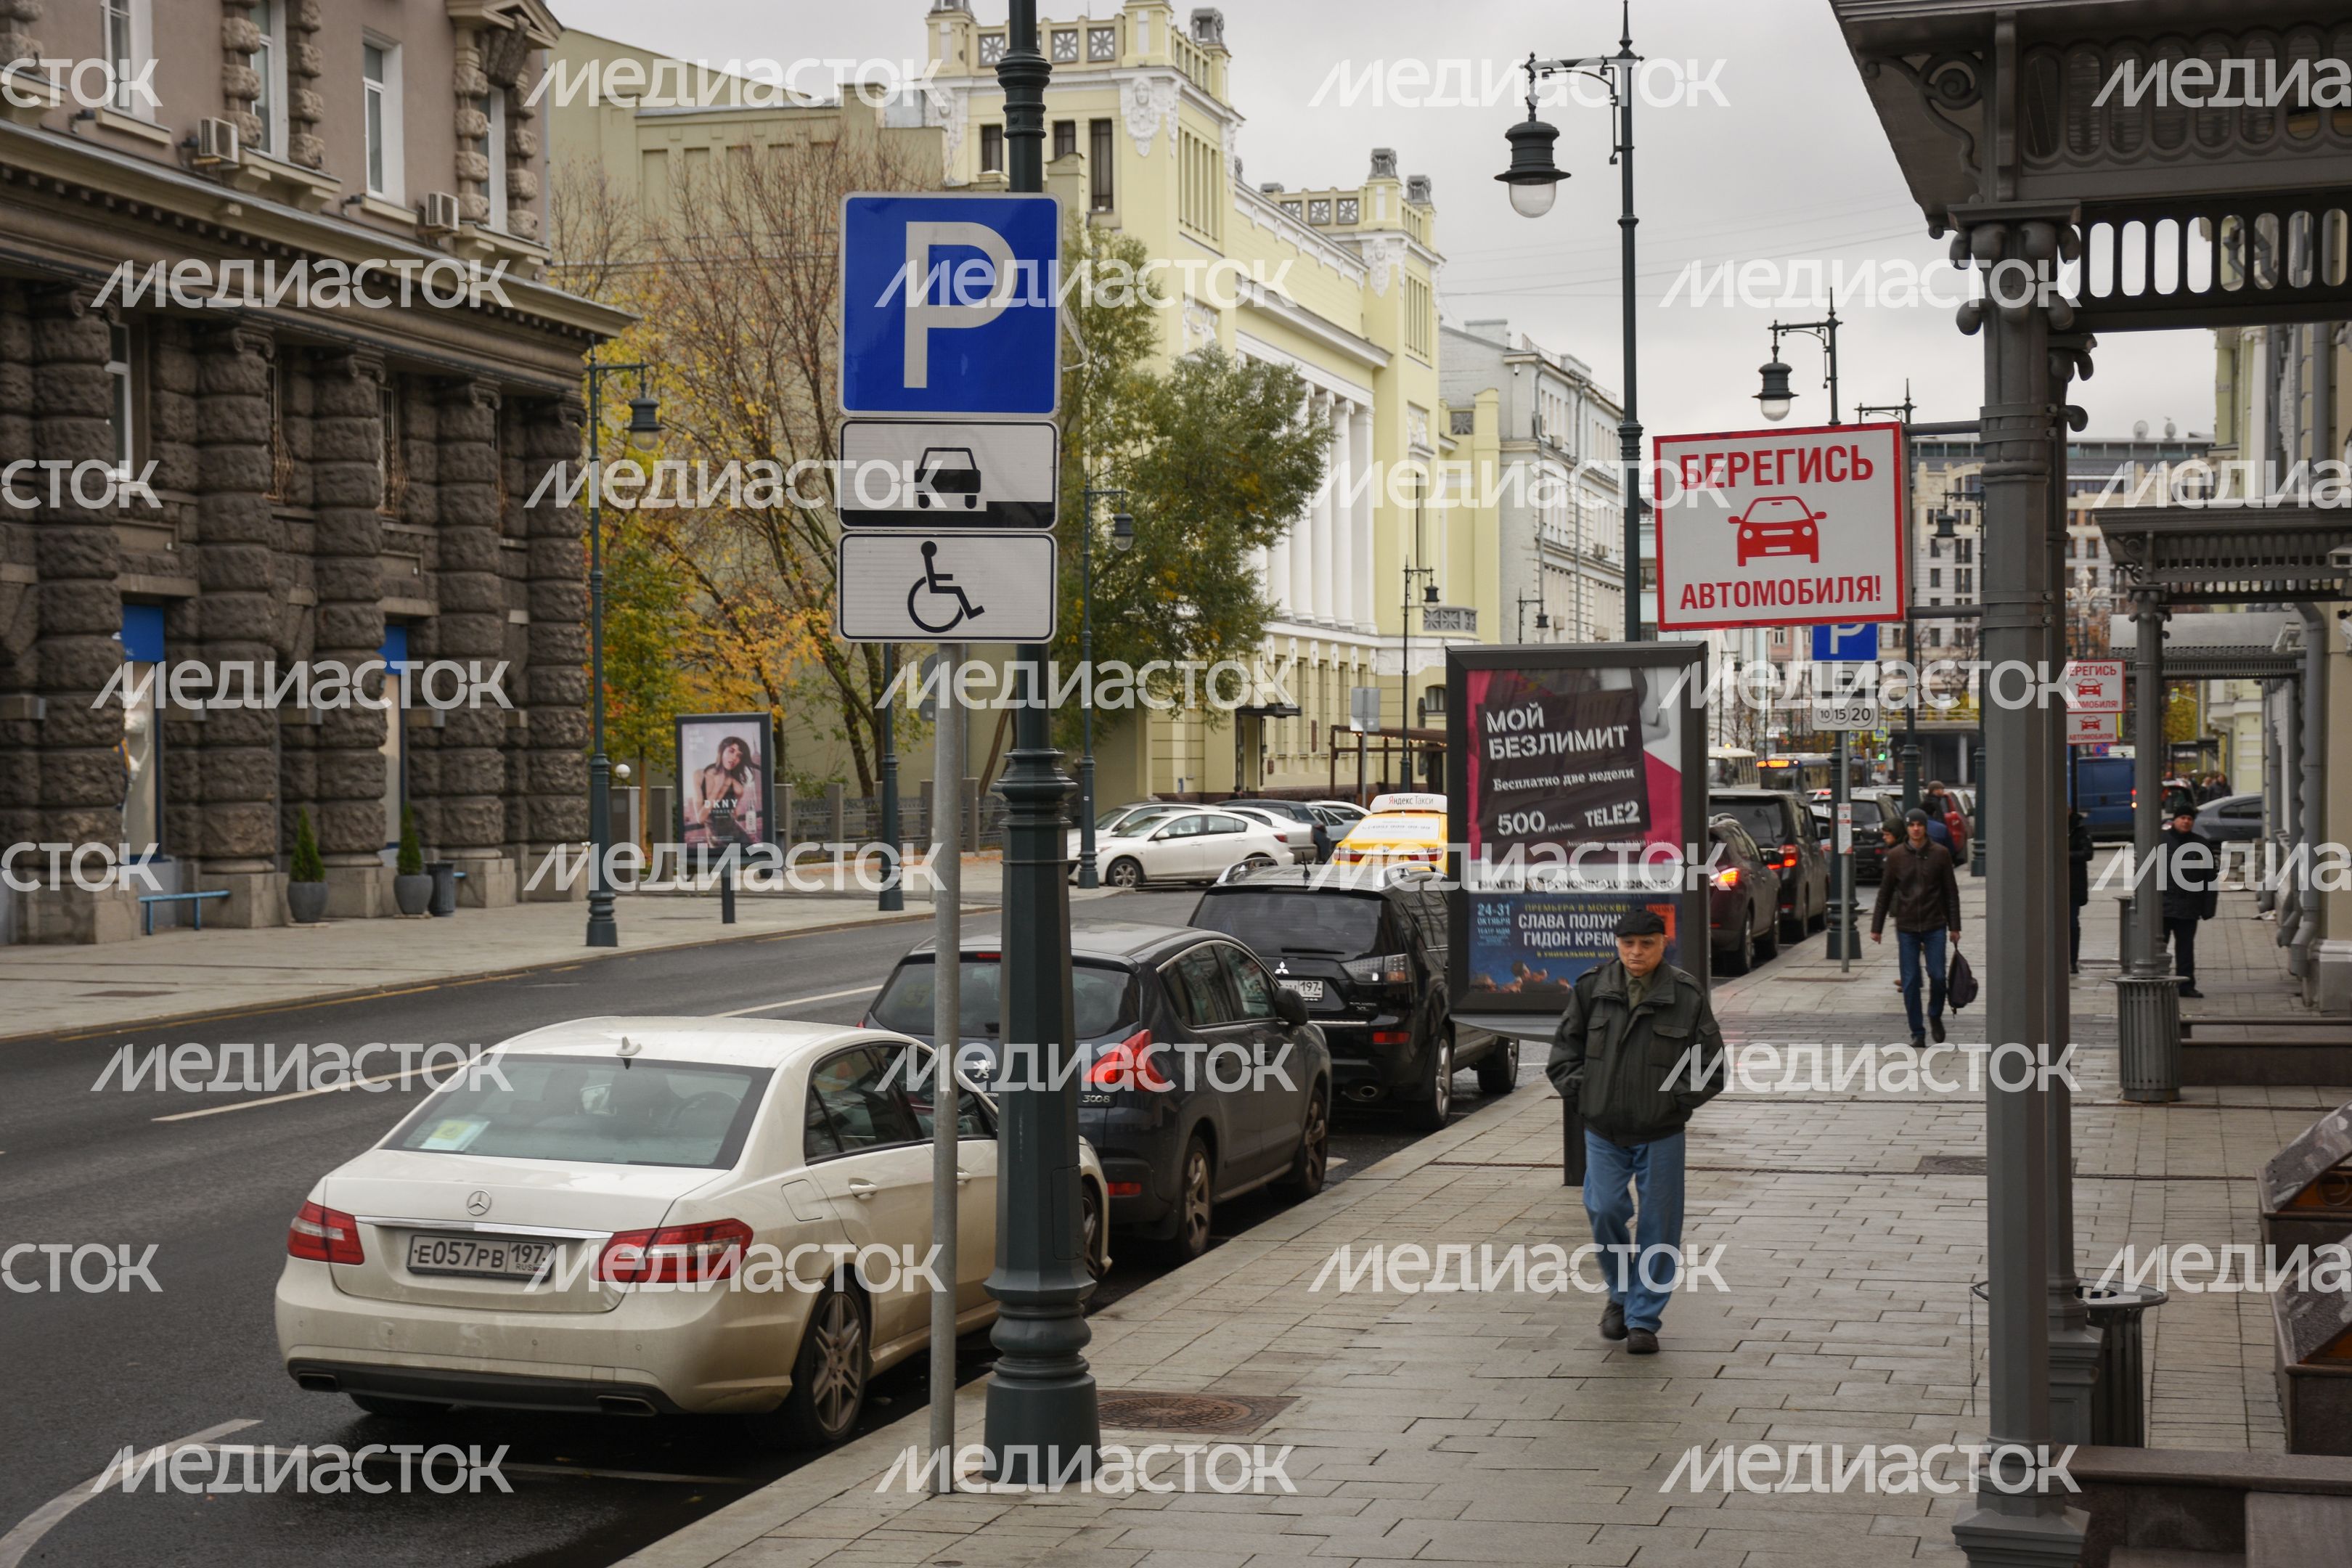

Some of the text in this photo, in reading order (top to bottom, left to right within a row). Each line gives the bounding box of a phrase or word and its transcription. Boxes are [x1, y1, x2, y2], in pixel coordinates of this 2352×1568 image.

[903, 221, 1018, 389] P
[1679, 444, 1874, 490] БЕРЕГИСЬ
[1679, 574, 1882, 611] АВТОМОБИЛЯ!
[1486, 701, 1545, 734] МОЙ
[1820, 707, 1871, 721] 10 15 20
[1488, 724, 1630, 761] БЕЗЛИМИТ
[1493, 767, 1636, 792] Бесплатно две недели
[704, 799, 738, 809] DKNY
[1389, 795, 1434, 805] Яндекс Такси
[1498, 810, 1546, 837] 500
[1584, 800, 1641, 828] TELE2
[1477, 902, 1510, 917] 24-31
[1518, 913, 1565, 929] СЛАВА
[1524, 931, 1571, 949] ГИДОН
[1575, 931, 1617, 947] КРЕМ
[1299, 981, 1319, 992] 197
[1082, 1094, 1111, 1103] 3008
[510, 1244, 544, 1265] 197
